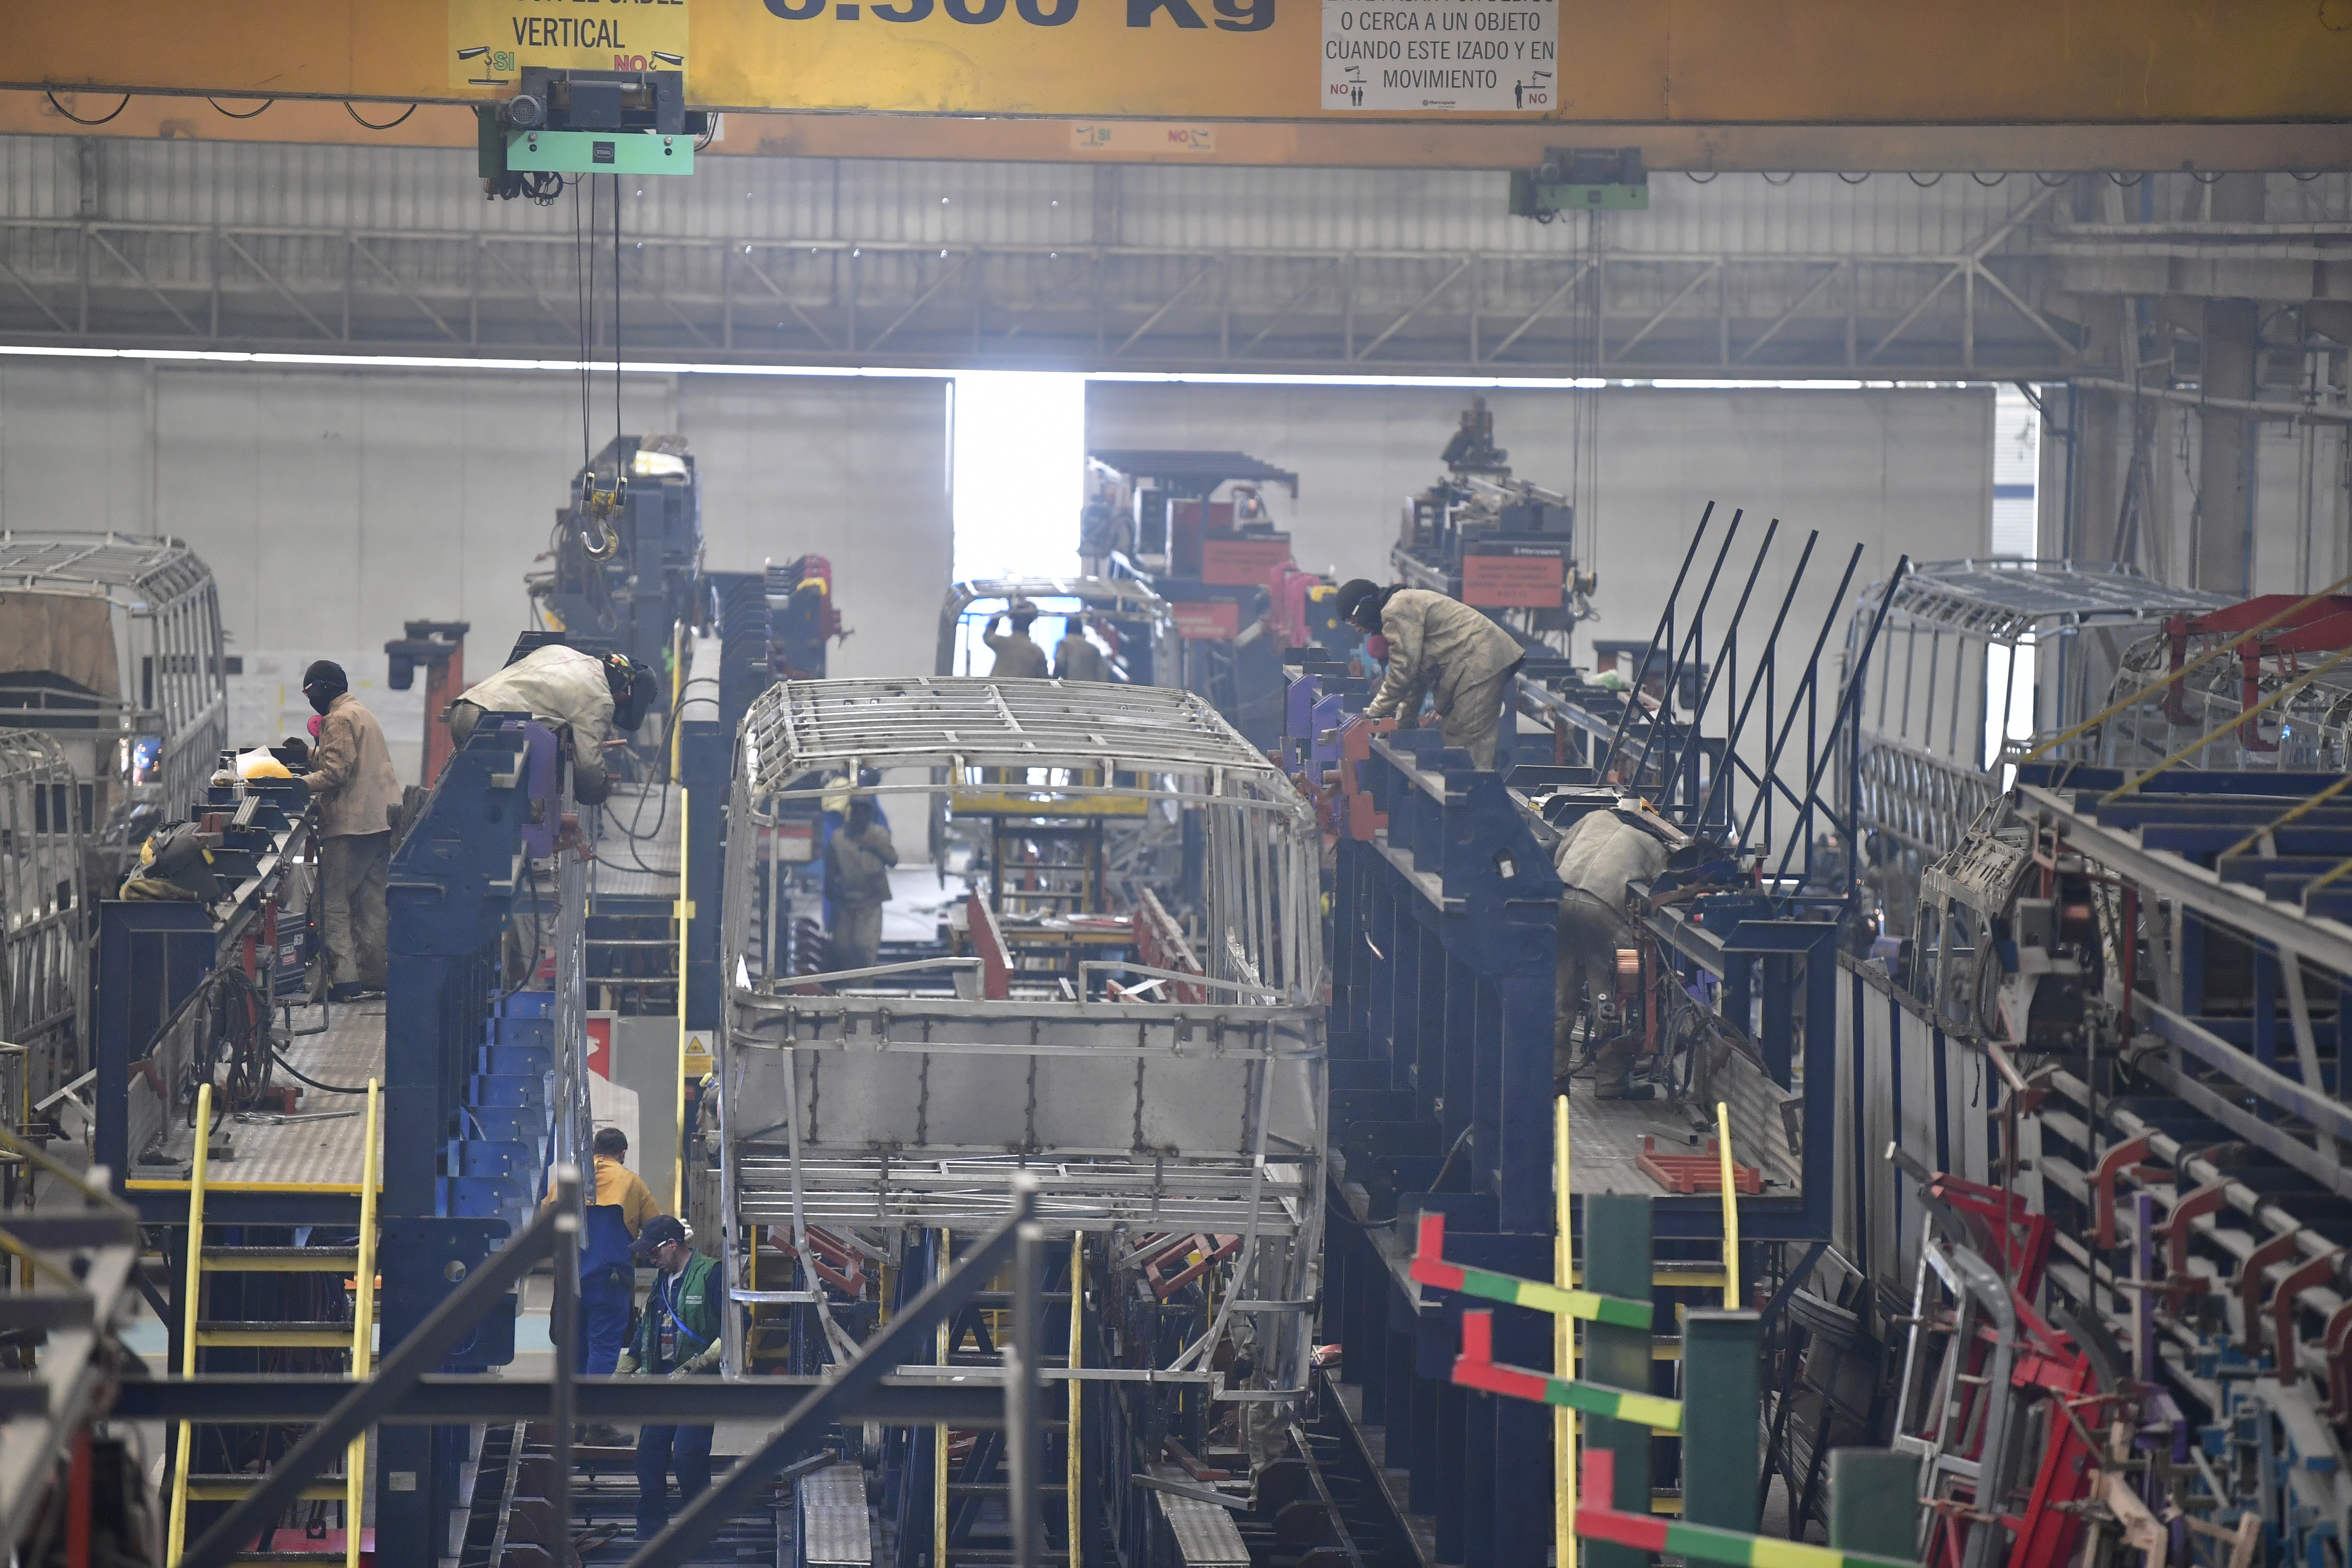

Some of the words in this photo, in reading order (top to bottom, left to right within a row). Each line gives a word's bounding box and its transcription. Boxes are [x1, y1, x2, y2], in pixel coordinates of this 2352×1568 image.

[1341, 11, 1353, 30] O
[1360, 12, 1419, 30] CERCA
[1424, 12, 1436, 30] A
[1443, 12, 1467, 30] UN
[1475, 12, 1540, 31] OBJETO
[512, 16, 626, 48] VERTICAL
[1326, 41, 1401, 59] CUANDO
[1408, 41, 1451, 59] ESTE
[1457, 41, 1508, 60] IZADO
[1514, 41, 1525, 60] Y
[1531, 41, 1554, 60] EN
[493, 51, 514, 71] SI
[614, 54, 647, 71] NO
[1383, 70, 1497, 88] MOVIMIENTO
[1330, 84, 1348, 94] NO
[1529, 93, 1547, 104] NO
[1098, 128, 1111, 142] SI
[1168, 129, 1188, 142] NO
